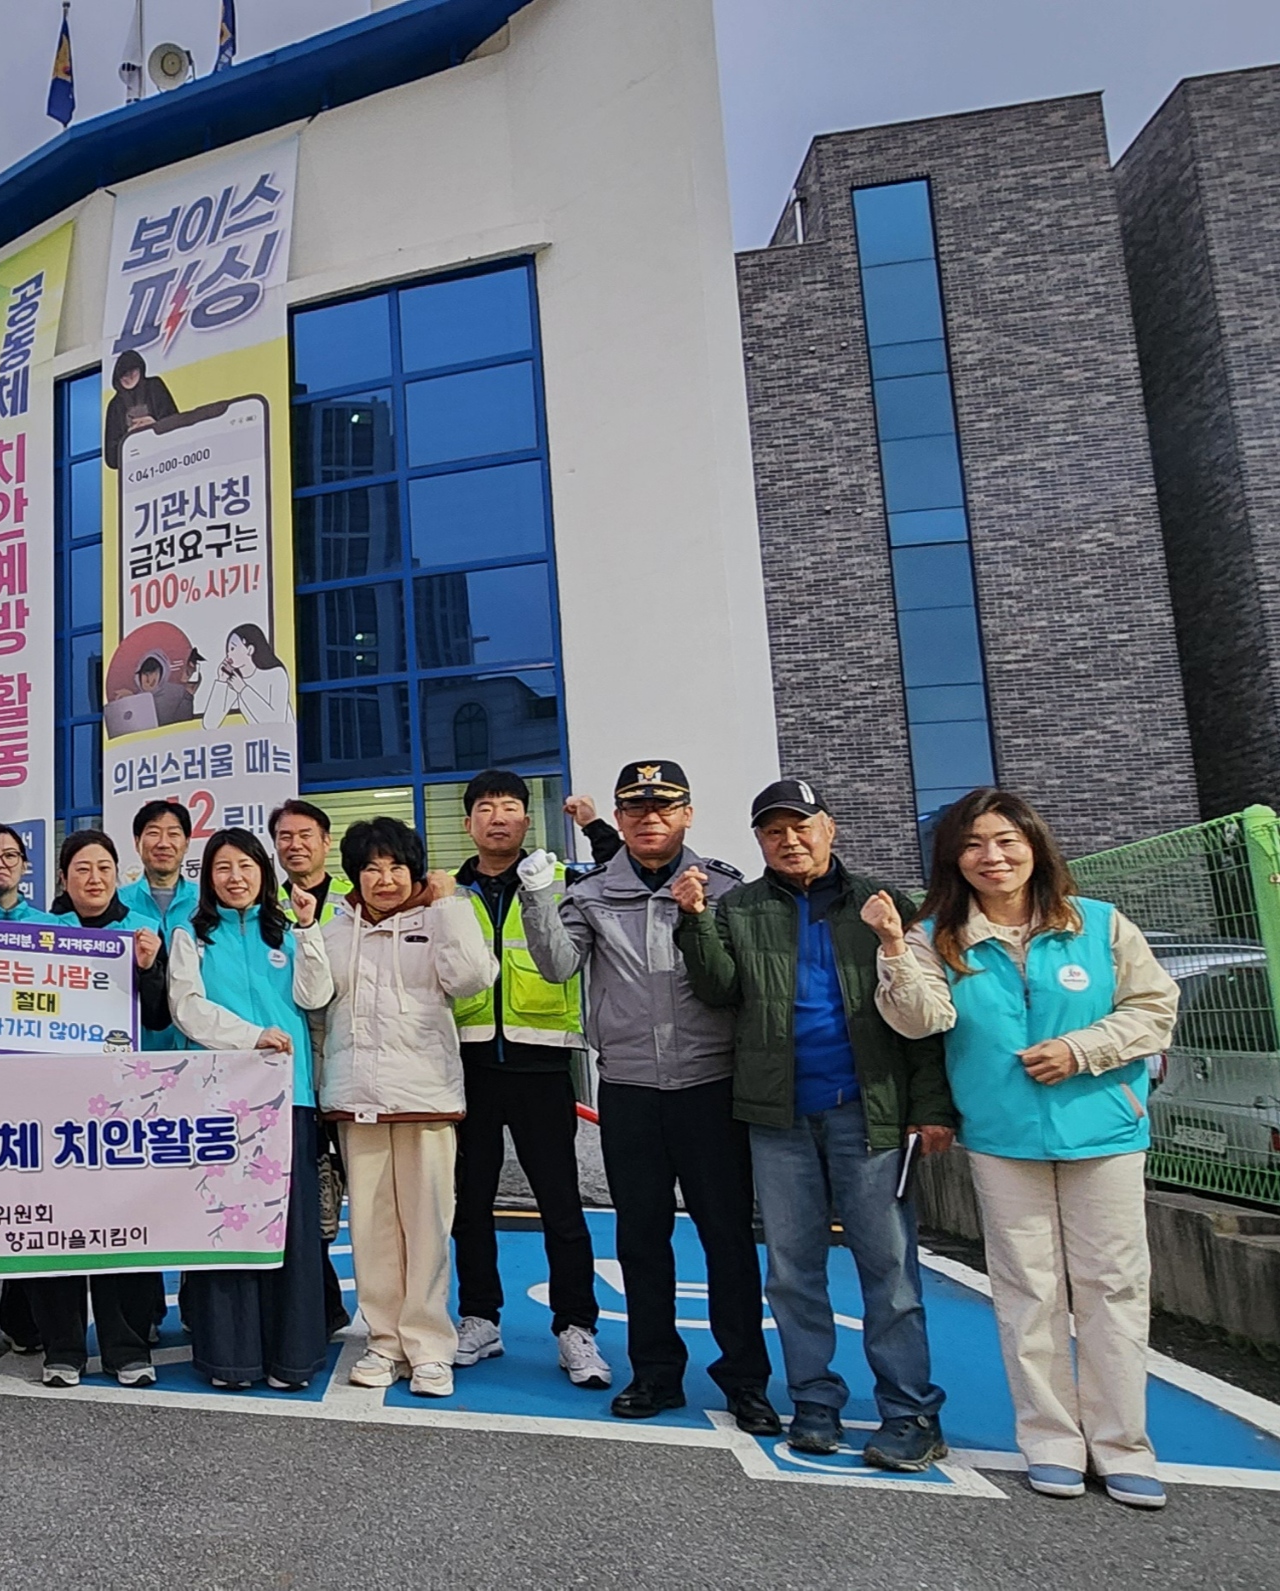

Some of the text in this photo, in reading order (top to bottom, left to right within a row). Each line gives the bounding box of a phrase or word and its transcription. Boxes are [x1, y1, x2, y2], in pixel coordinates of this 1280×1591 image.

[121, 172, 285, 272] 보이스
[111, 230, 279, 356] 피싱
[134, 475, 251, 539] 기관사칭
[129, 522, 258, 580] 금전요구는
[129, 563, 260, 617] 100% 사기!
[113, 739, 291, 795] 의심스러울 때는
[38, 931, 56, 951] 꼭
[58, 937, 121, 955] 지켜주세요!
[15, 991, 56, 1013] 절대
[42, 964, 110, 990] 사람은
[48, 1021, 106, 1043] 않아요
[52, 1112, 241, 1172] 치안활동
[4, 1226, 148, 1253] 향교마을지킴이
